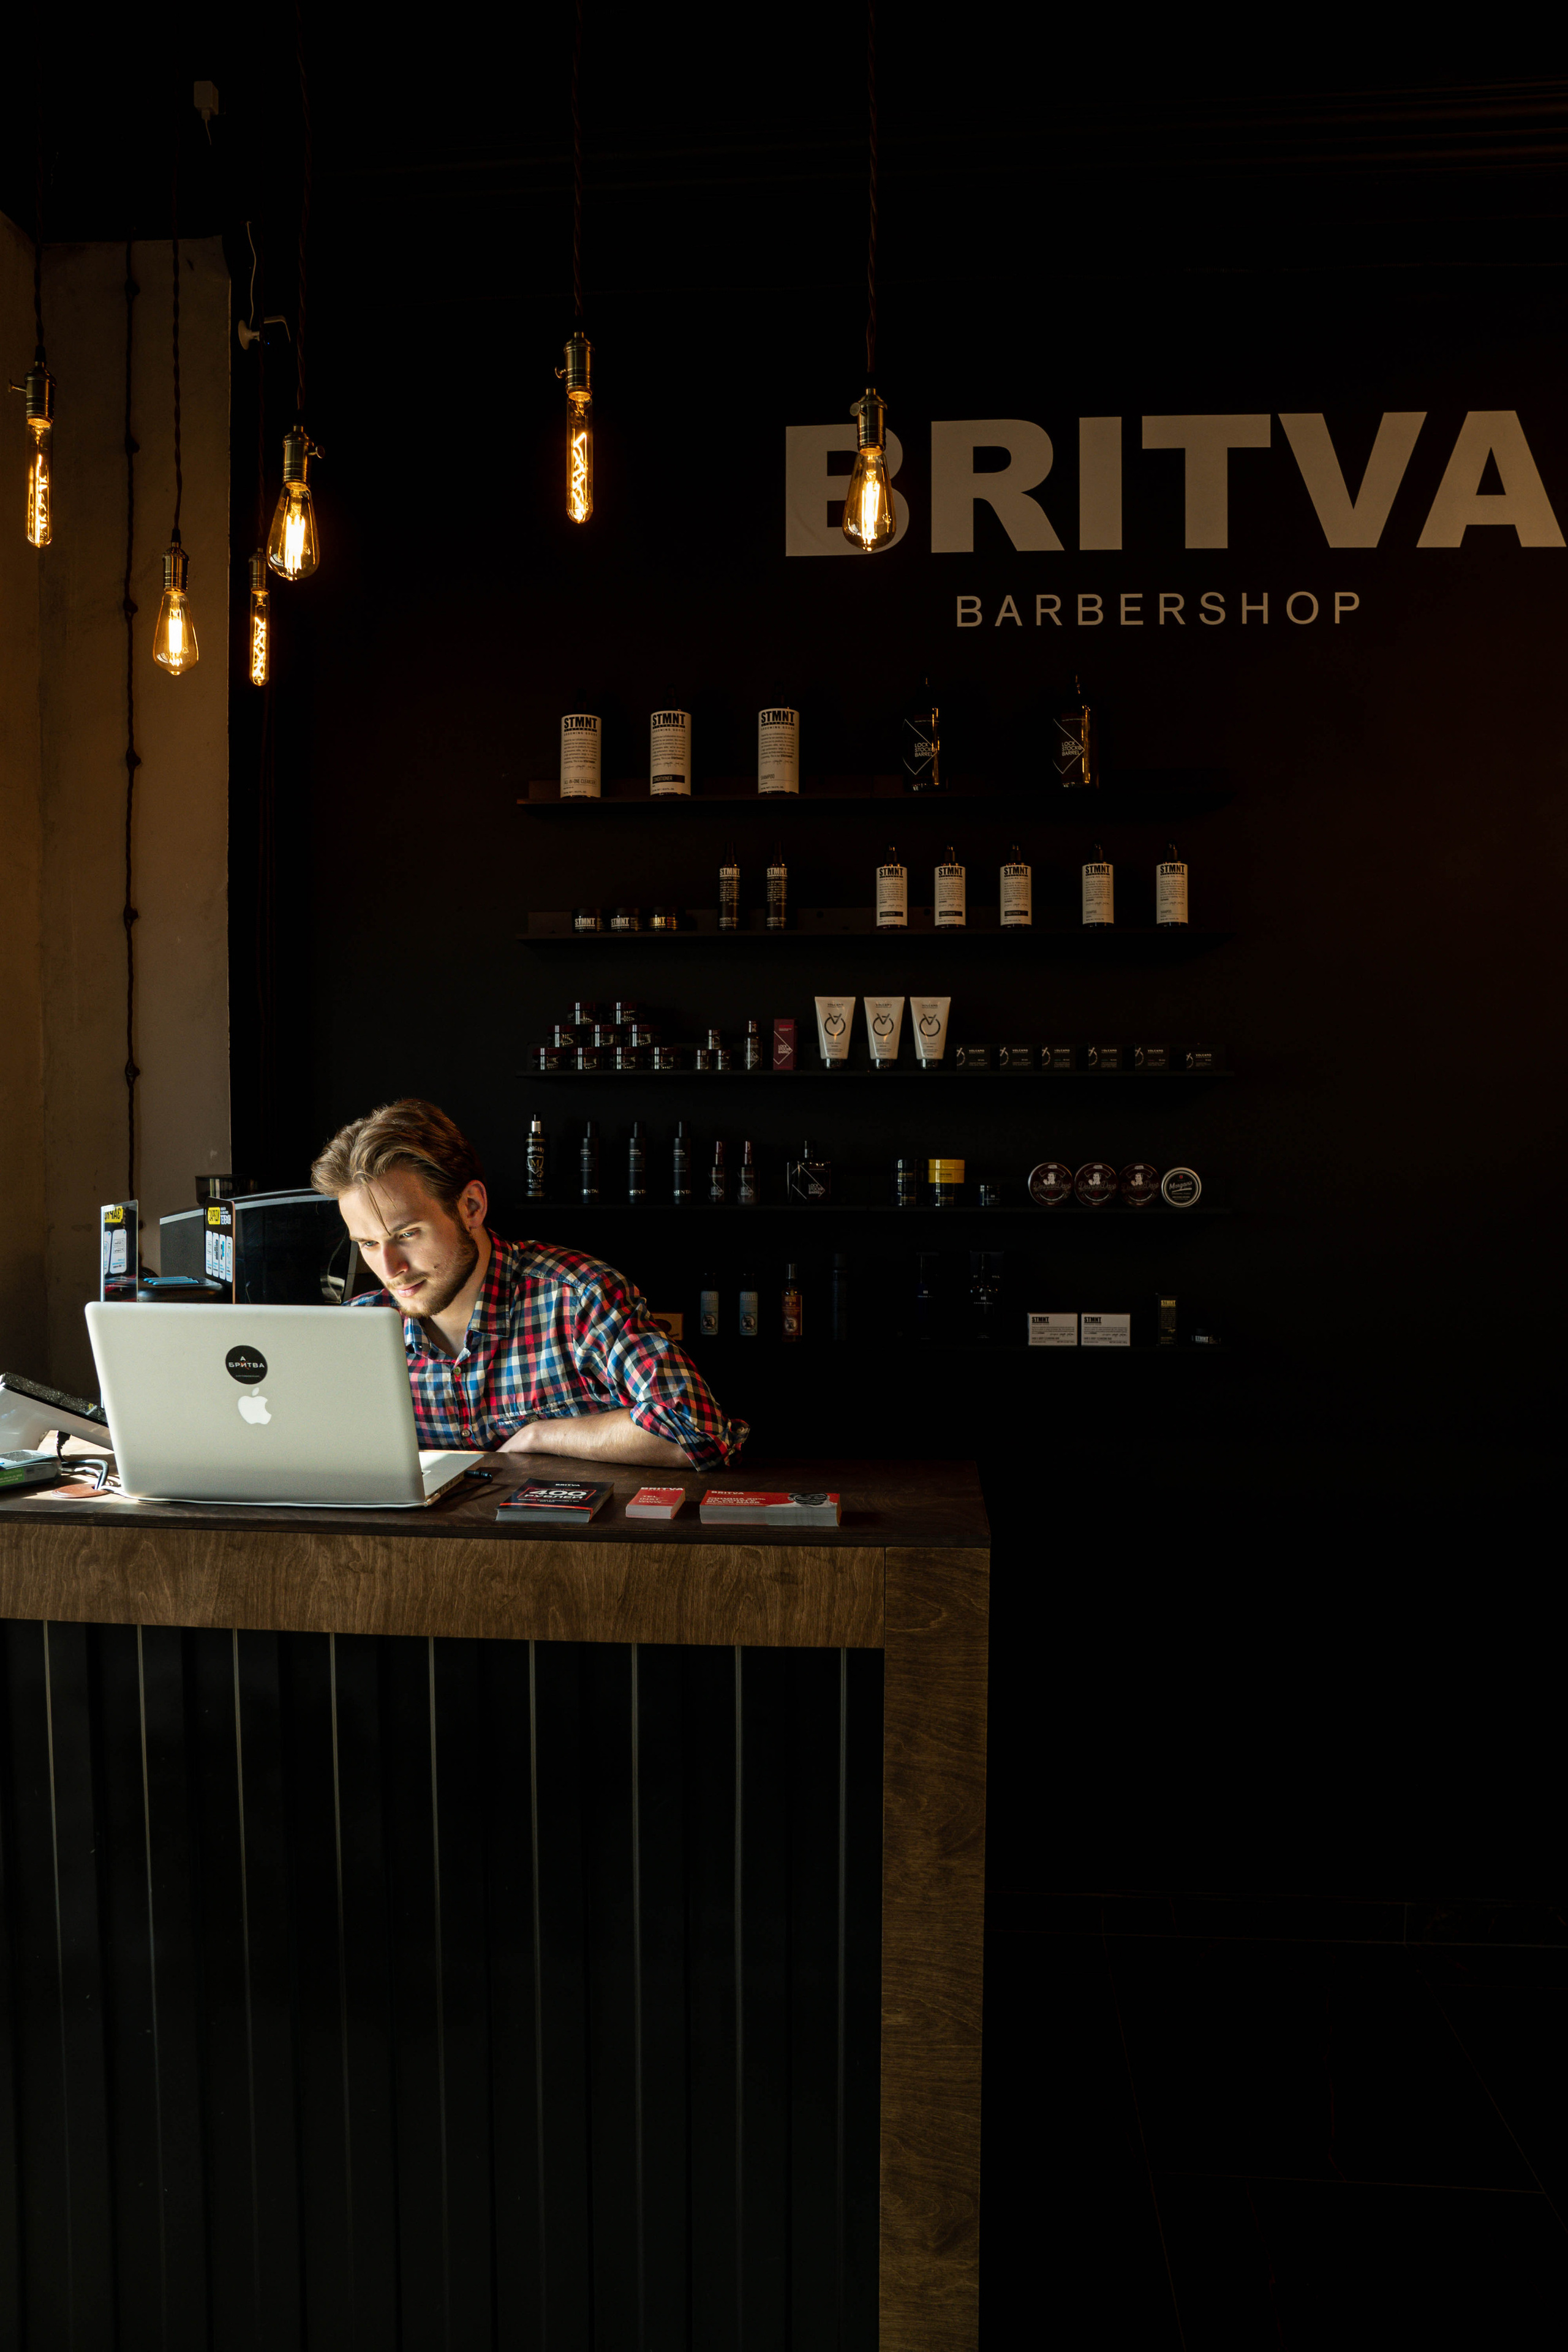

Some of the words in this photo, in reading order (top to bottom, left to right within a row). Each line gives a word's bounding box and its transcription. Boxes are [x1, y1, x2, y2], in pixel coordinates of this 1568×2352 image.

[785, 410, 1567, 557] BRITVA
[957, 591, 1360, 628] BARBERSHOP
[653, 713, 685, 725] STMNT
[761, 710, 794, 723] STMNT
[564, 717, 597, 728] STMNT
[880, 867, 903, 876] STMNT
[938, 867, 963, 876] STMNT
[1004, 867, 1028, 875] STMNT
[1085, 865, 1110, 874] STMNT
[1160, 865, 1185, 873] STMNT
